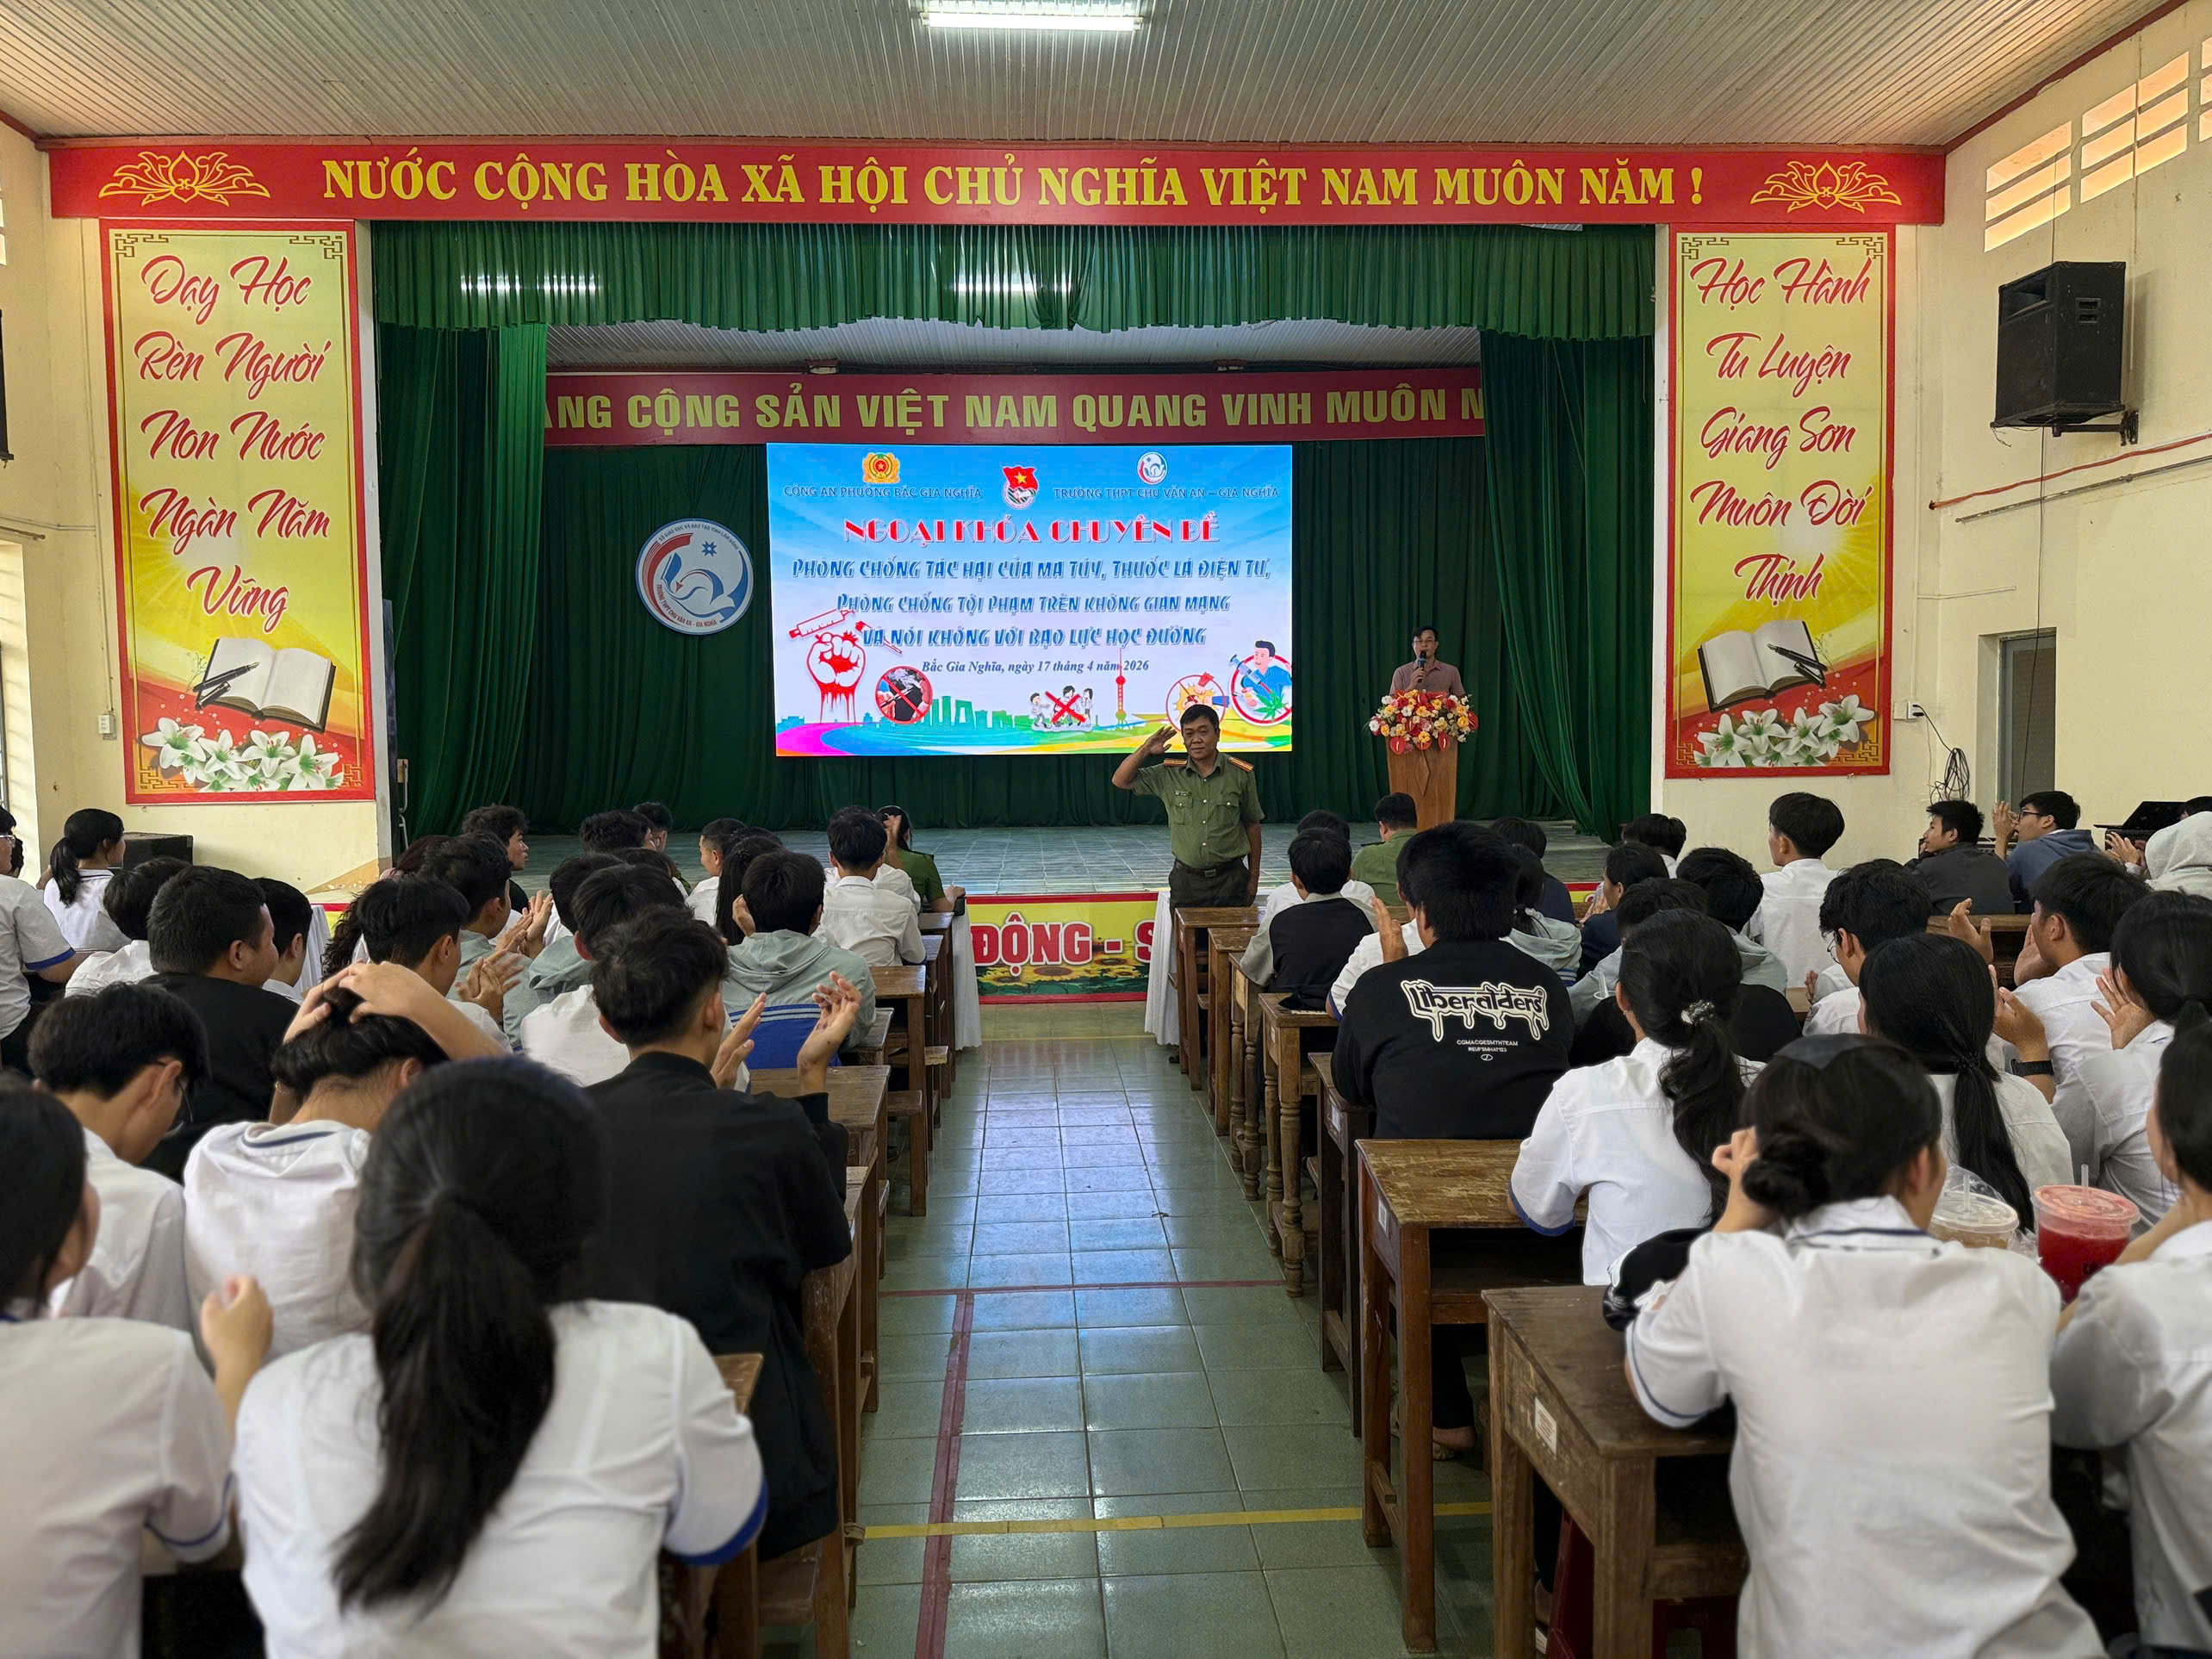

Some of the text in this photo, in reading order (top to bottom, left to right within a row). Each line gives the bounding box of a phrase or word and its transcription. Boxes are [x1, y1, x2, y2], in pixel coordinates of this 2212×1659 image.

[324, 147, 1702, 214] NƯỚC CỘNG HÒA XÃ HỘI CHỦ NGHĨA VIỆT NAM MUÔN NĂM !
[141, 255, 310, 324] Dạy Học
[1691, 258, 1872, 311] Học Hành
[134, 331, 331, 400] Rèn Người
[1706, 332, 1851, 398] Tu Luyện
[141, 411, 324, 459] Non Nước
[628, 388, 740, 437] CỘNG
[755, 382, 840, 427] SẢN
[857, 388, 949, 435] VIỆT
[965, 395, 1058, 427] NAM
[1072, 395, 1206, 432] QUANG
[1222, 393, 1311, 426] VINH
[1327, 384, 1445, 423] MUÔN
[1702, 407, 1855, 469] Giang Sơn
[784, 483, 817, 497] CÔNG
[821, 488, 836, 496] AN
[920, 488, 941, 497] GIA
[1106, 488, 1134, 498] THPT
[1138, 488, 1160, 498] CHU
[1190, 488, 1204, 498] AN
[1219, 488, 1239, 498] GIA
[1691, 481, 1871, 525] Muôn Đời
[140, 489, 329, 554] Ngàn Năm
[844, 510, 1220, 548] NGOẠI KHÓA CHUYÊN ĐỀ
[860, 555, 921, 578] CHỐNG
[963, 561, 992, 581] HẠI
[1037, 561, 1065, 577] MA
[1113, 556, 1168, 578] THUỐC
[1735, 553, 1824, 605] Thịnh
[187, 565, 288, 633] Vững
[898, 592, 954, 613] CHỐNG
[988, 595, 1035, 616] PHẠM
[1144, 596, 1181, 612] GIAN
[1184, 595, 1231, 614] MẠNG
[1028, 628, 1066, 649] BẠO
[1106, 628, 1142, 649] HỌC
[922, 658, 1149, 675] Bắc Gia Nghĩa, ngày 17 tháng 4 năm 2026
[972, 913, 1091, 975] ĐỘNG
[1106, 941, 1121, 952] -
